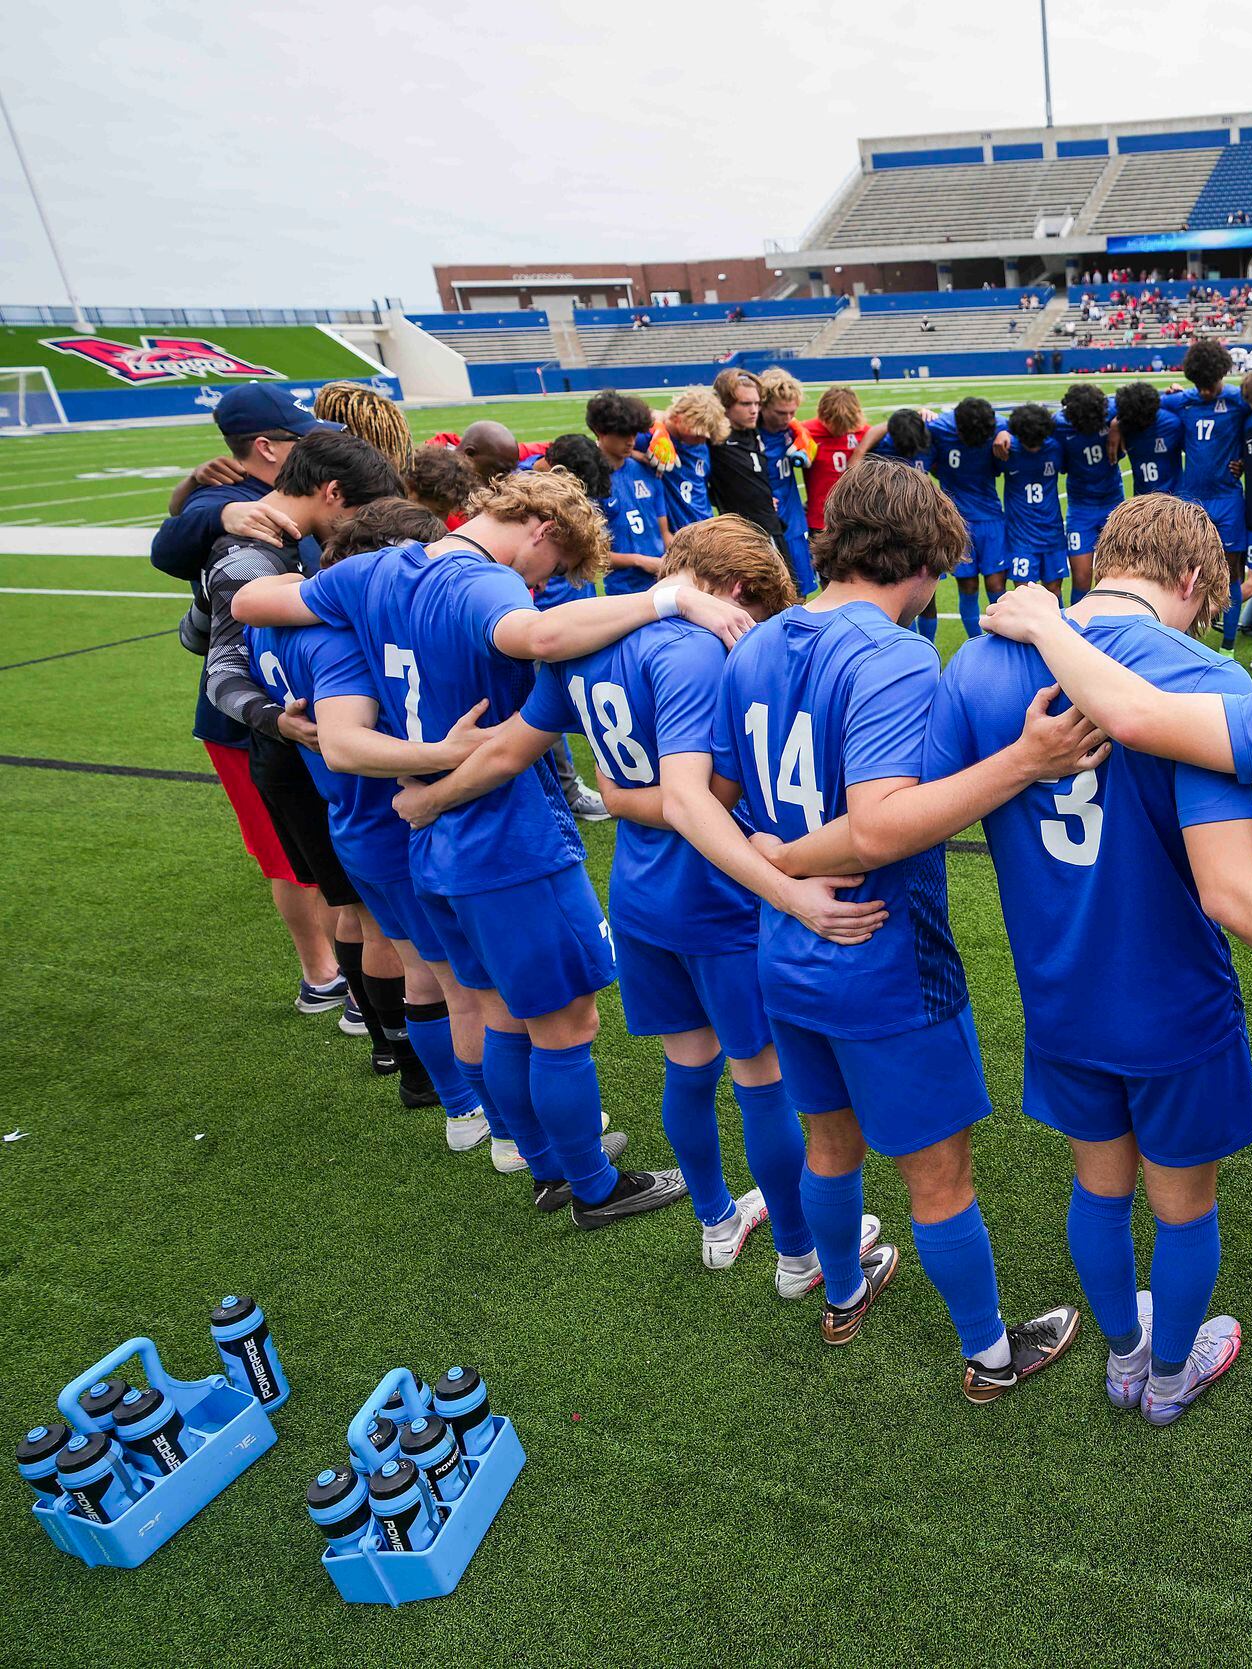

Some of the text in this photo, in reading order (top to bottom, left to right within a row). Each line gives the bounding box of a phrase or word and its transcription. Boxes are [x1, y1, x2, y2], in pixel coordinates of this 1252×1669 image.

[1196, 419, 1215, 441] 17
[750, 452, 762, 472] 1
[833, 451, 847, 472] 0
[949, 449, 961, 468] 6
[1083, 444, 1102, 465] 19
[776, 457, 791, 480] 10
[1140, 462, 1159, 483] 16
[680, 481, 693, 504] 8
[1025, 483, 1044, 504] 13
[626, 510, 644, 535] 5
[1012, 557, 1029, 577] 13
[384, 643, 423, 742] 7
[568, 675, 655, 784] 18
[744, 701, 824, 834] 14
[1034, 766, 1104, 866] 3
[244, 1337, 273, 1400] POWERADE
[152, 1434, 181, 1472] ERADE
[73, 1491, 102, 1524] POWE
[384, 1519, 404, 1552] POWE
